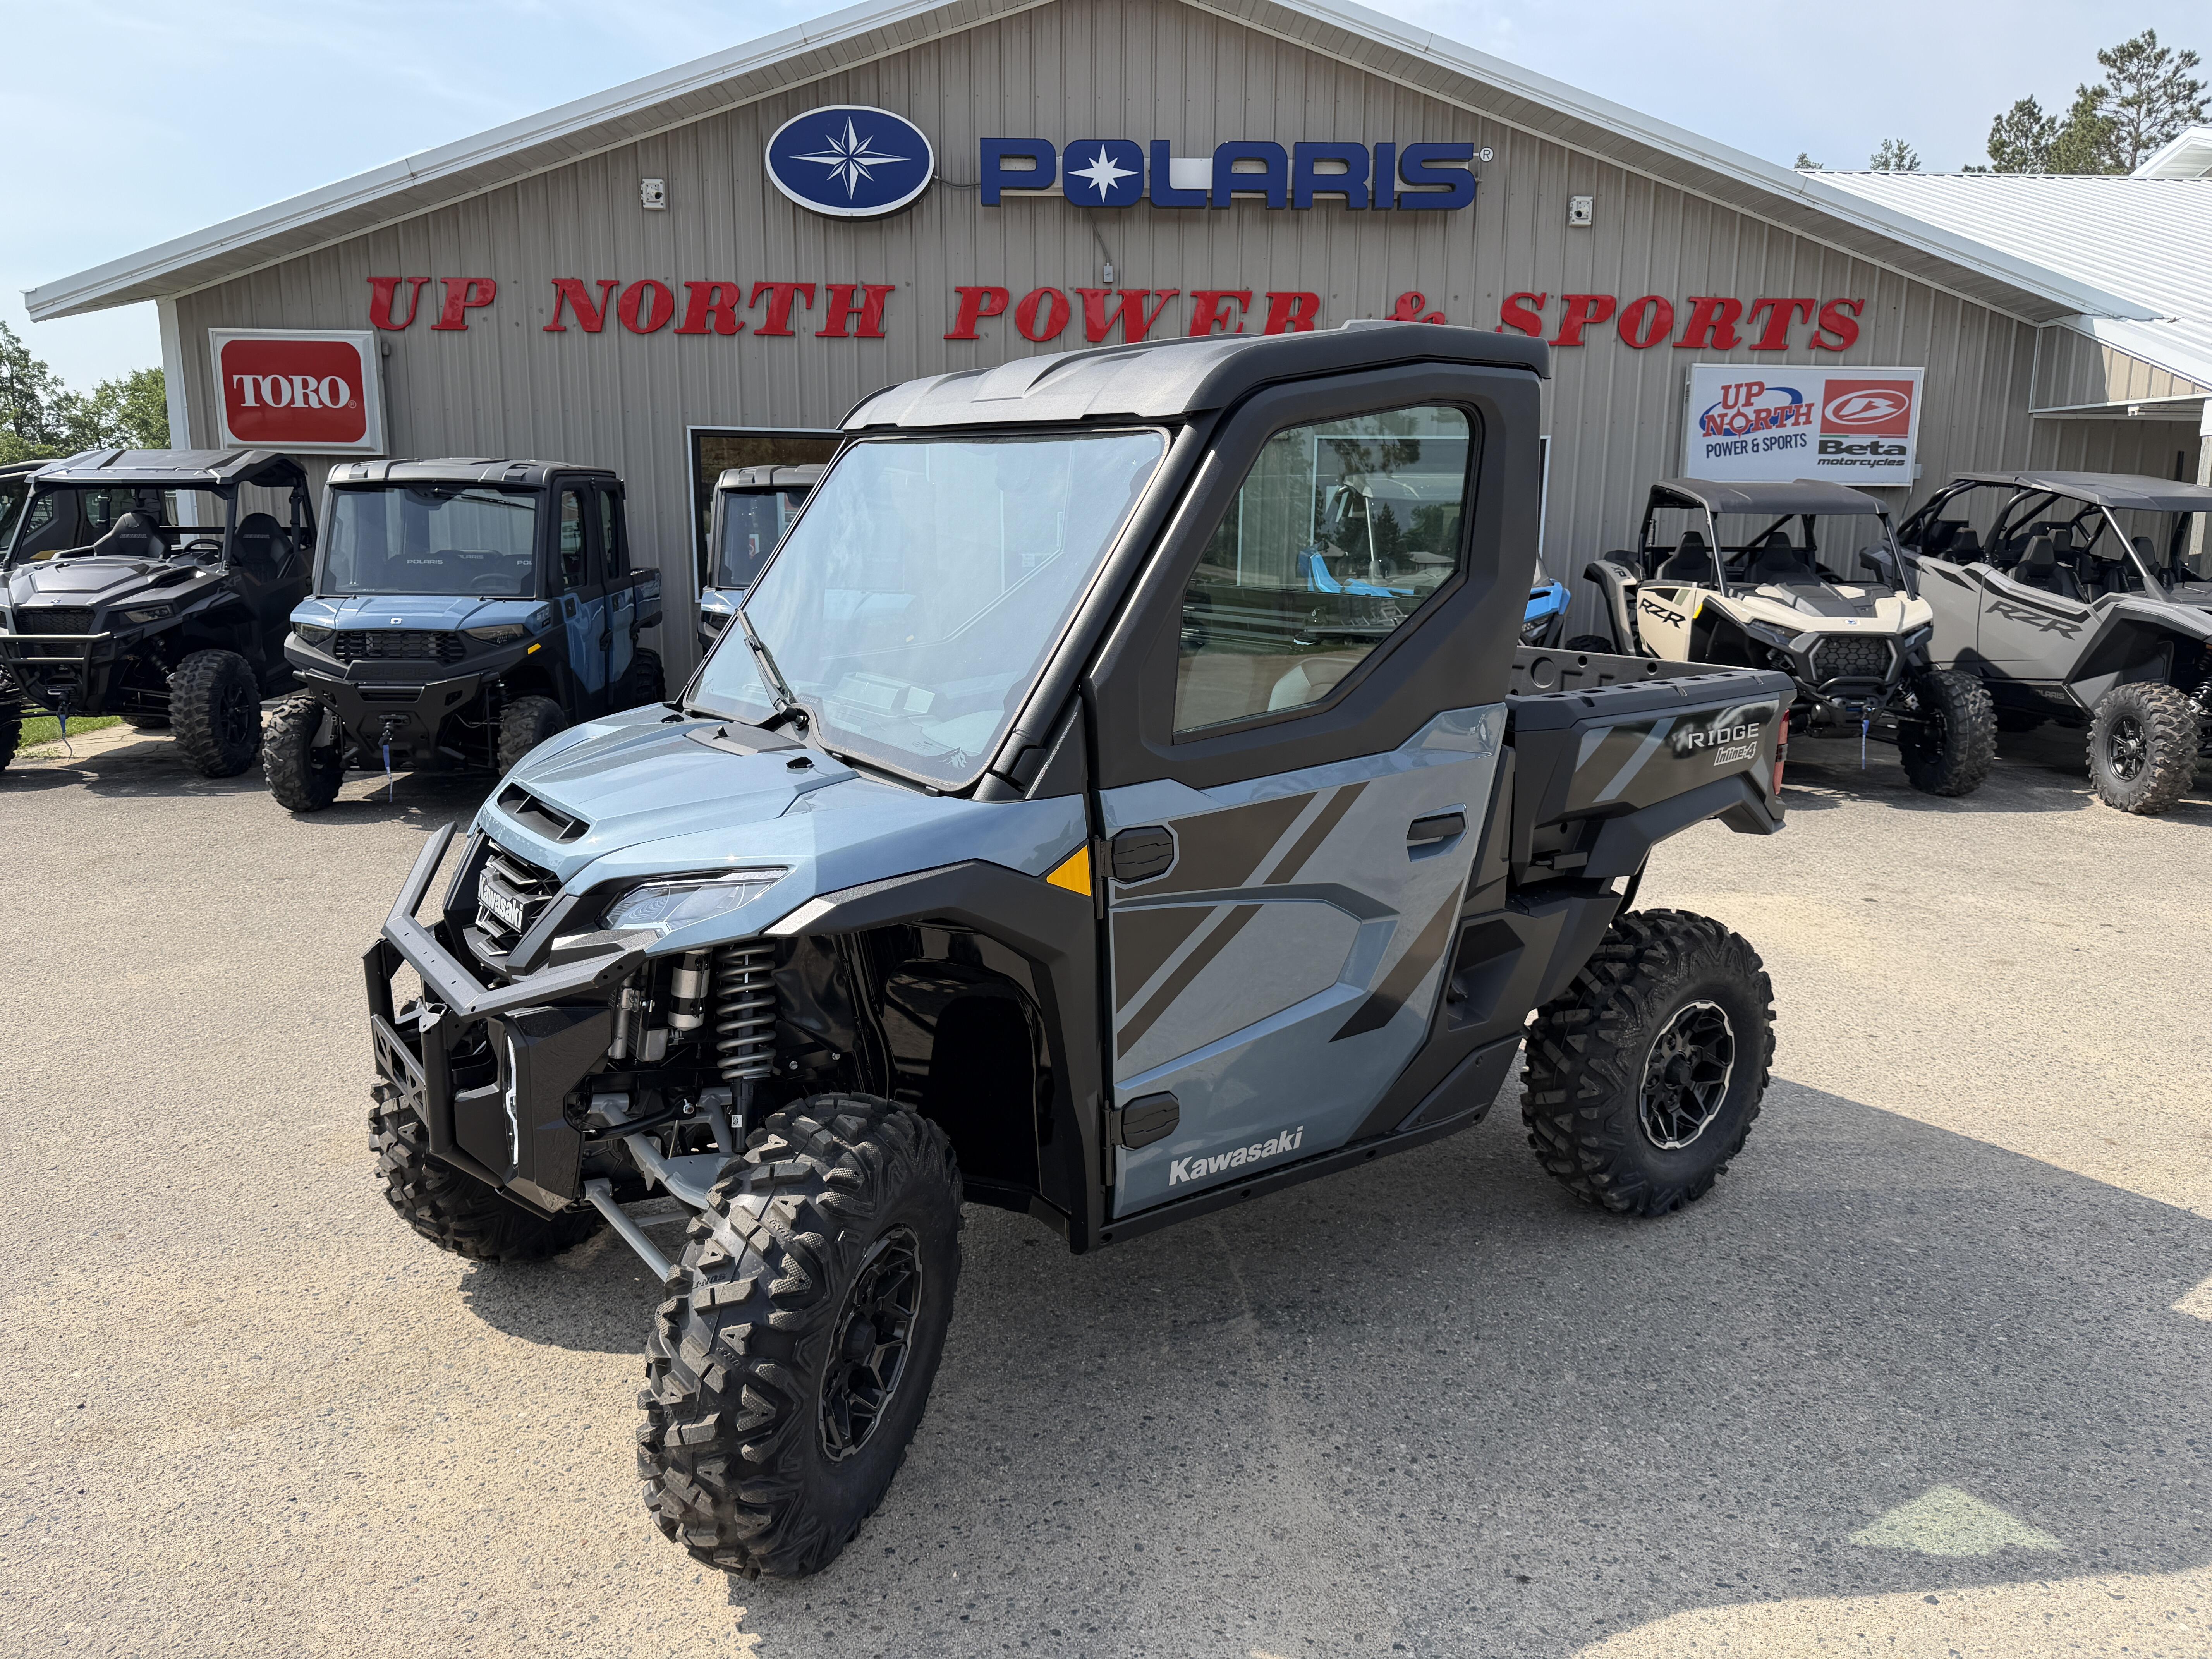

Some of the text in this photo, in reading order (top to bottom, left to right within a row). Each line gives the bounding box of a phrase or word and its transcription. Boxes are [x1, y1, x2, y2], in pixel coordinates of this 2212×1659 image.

[366, 276, 1865, 352] UP NORTH POWER & SPORTS
[1721, 381, 1765, 410] UP
[1702, 402, 1815, 438] NORTH
[1706, 433, 1807, 459] POWER & SPORTS
[1818, 440, 1907, 455] Beta
[1817, 457, 1906, 468] motorcycles
[1611, 567, 1626, 577] XP
[1638, 598, 1686, 629] RZR
[1984, 600, 2083, 641] RZR
[799, 695, 819, 704] RIDGE
[1688, 723, 1760, 749] RIDGE
[478, 874, 524, 929] Kawasaki
[1169, 1125, 1304, 1178] Kawasaki
